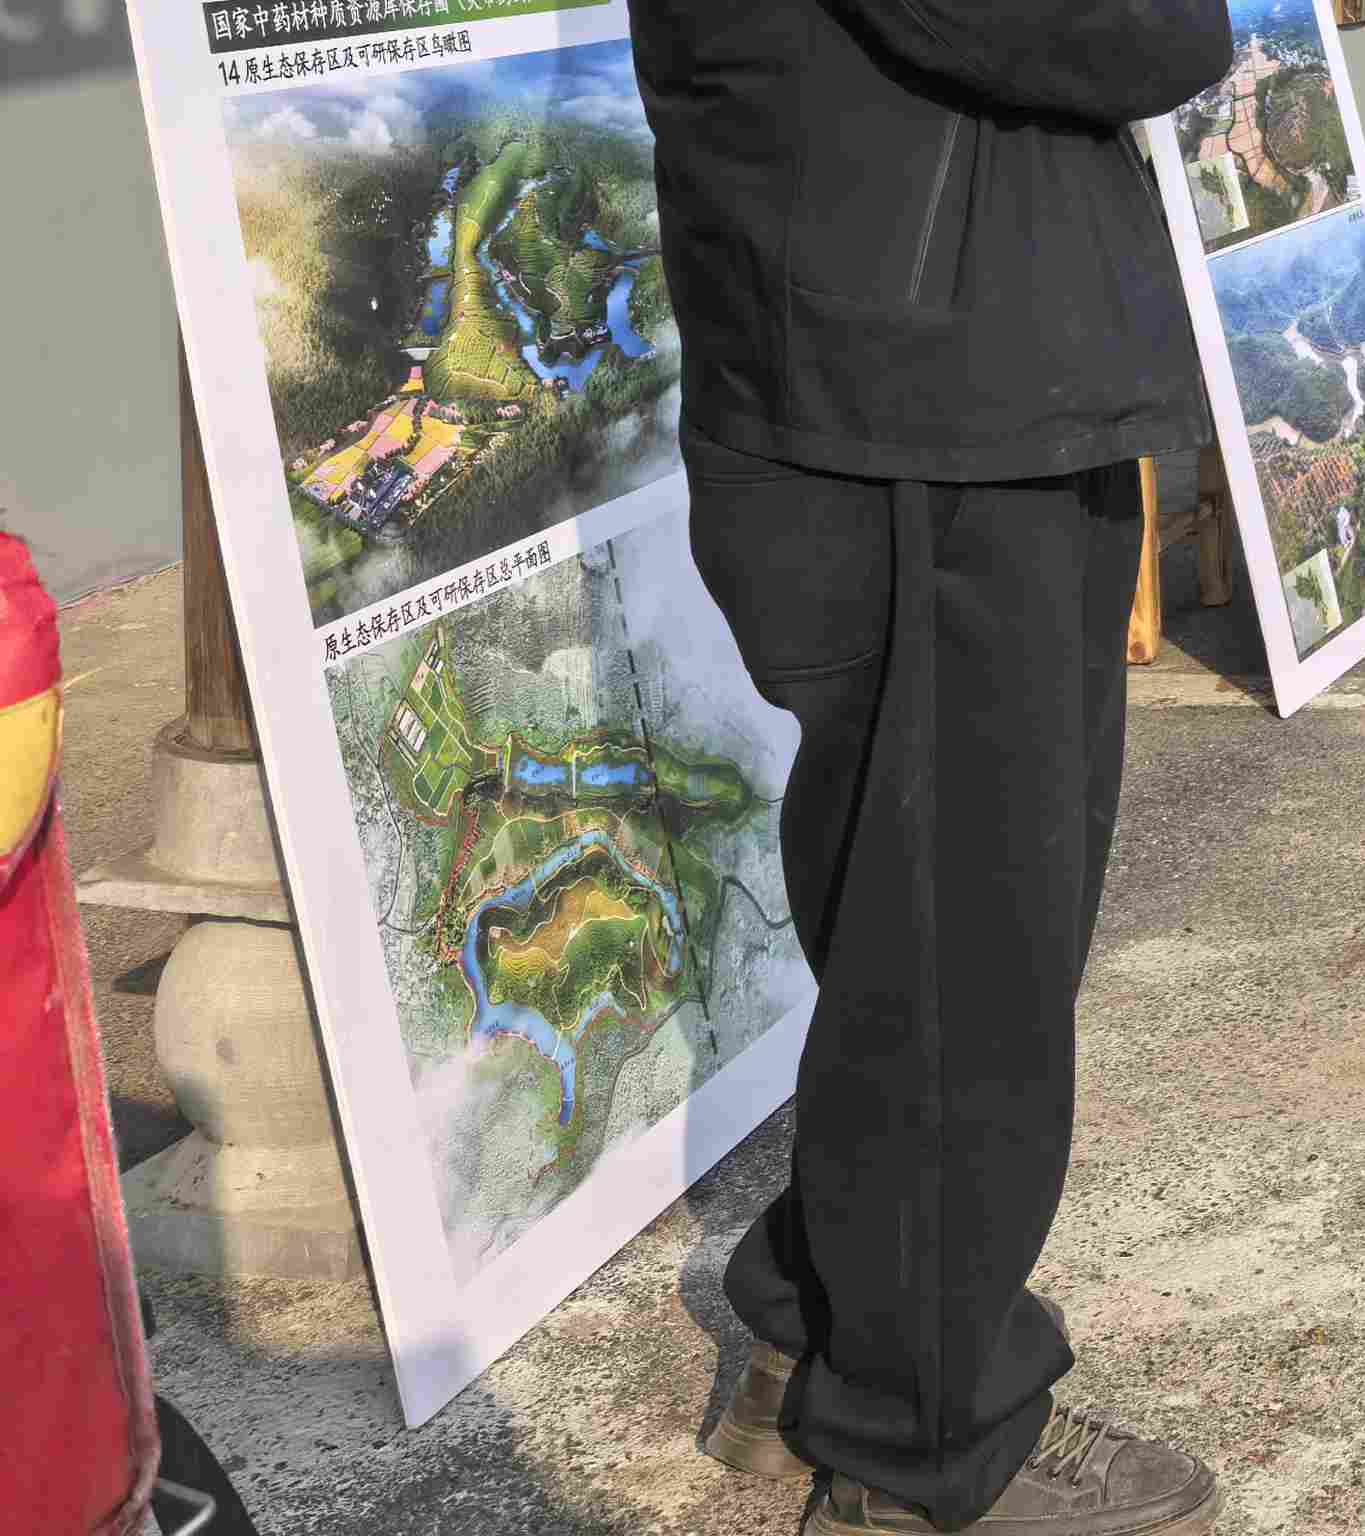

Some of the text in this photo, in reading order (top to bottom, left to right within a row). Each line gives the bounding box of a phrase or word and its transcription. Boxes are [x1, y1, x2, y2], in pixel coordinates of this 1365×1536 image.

[324, 540, 552, 661] 原生态保存区及可研保存区总平面图
